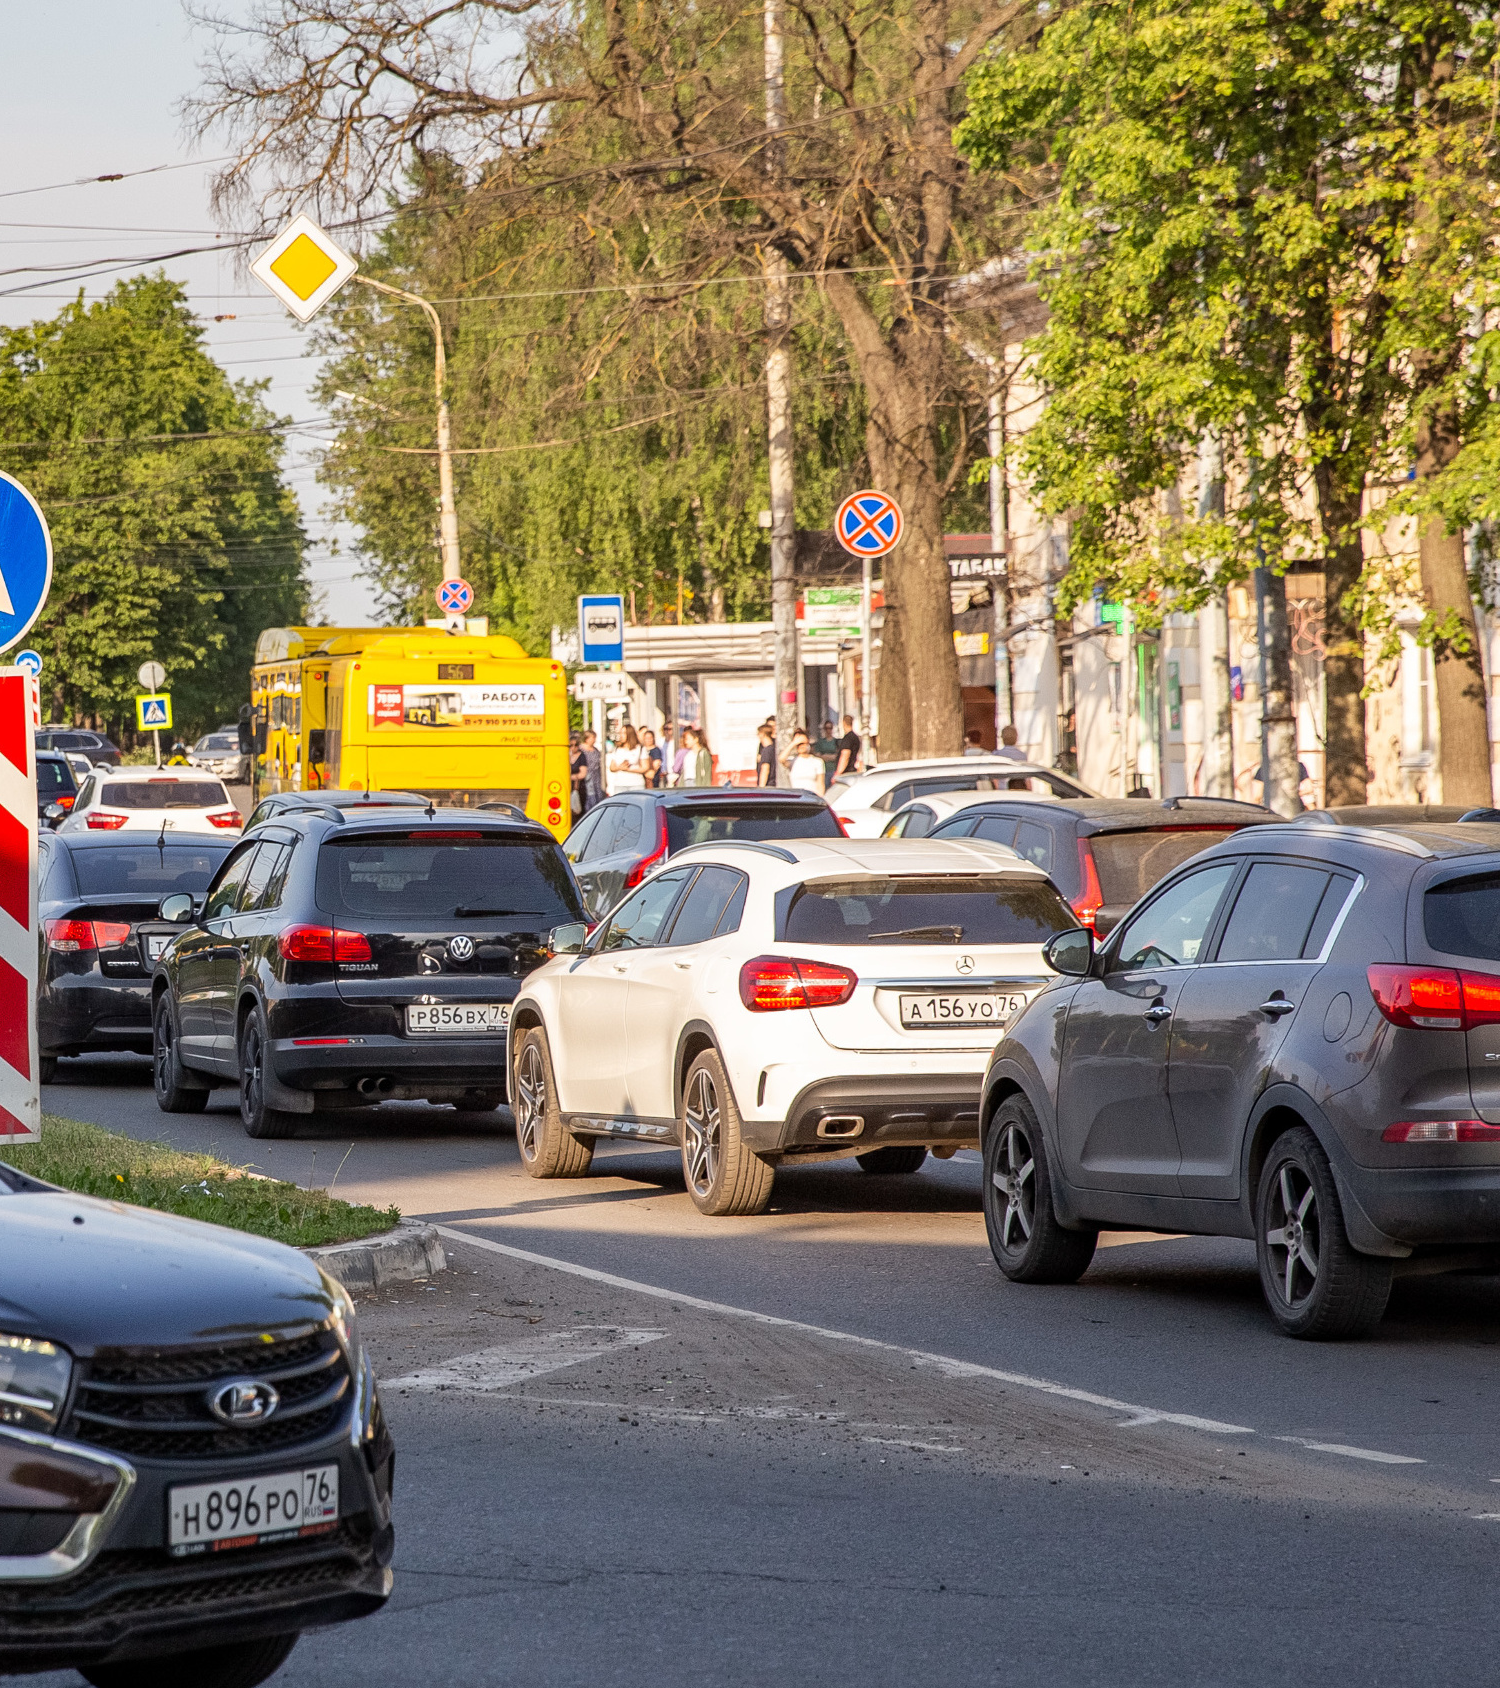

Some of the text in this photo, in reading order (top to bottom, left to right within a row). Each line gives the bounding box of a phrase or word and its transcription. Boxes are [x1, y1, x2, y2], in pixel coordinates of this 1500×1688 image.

[482, 692, 537, 702] РАБОТА
[338, 963, 379, 972] TIGUAN
[417, 1005, 508, 1025] Р856ВХ 76
[910, 996, 1018, 1019] А156УО 76
[183, 1471, 330, 1537] Н896РО 76
[304, 1507, 323, 1517] RUS
